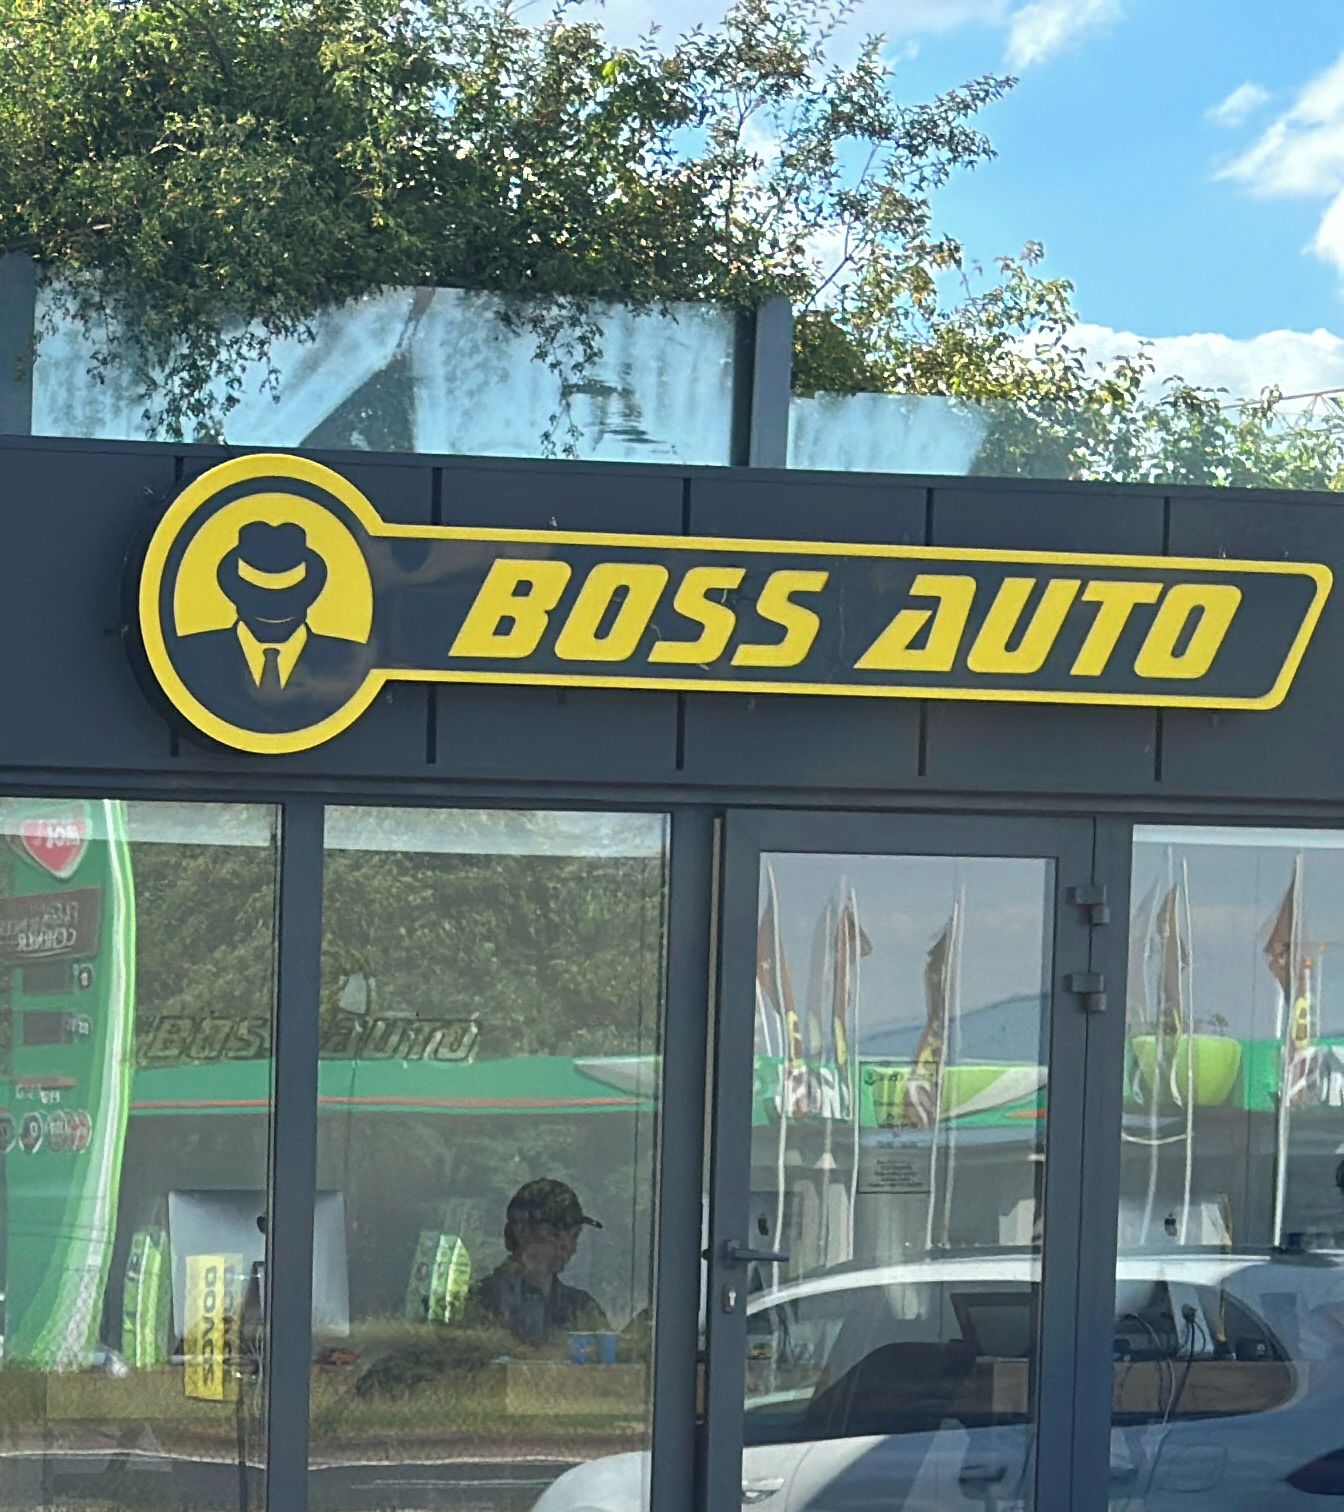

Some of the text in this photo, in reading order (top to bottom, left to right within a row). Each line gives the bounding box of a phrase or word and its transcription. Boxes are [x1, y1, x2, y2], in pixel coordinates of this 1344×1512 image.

[449, 558, 1243, 679] BOSS AUTO
[147, 1015, 272, 1060] BOS
